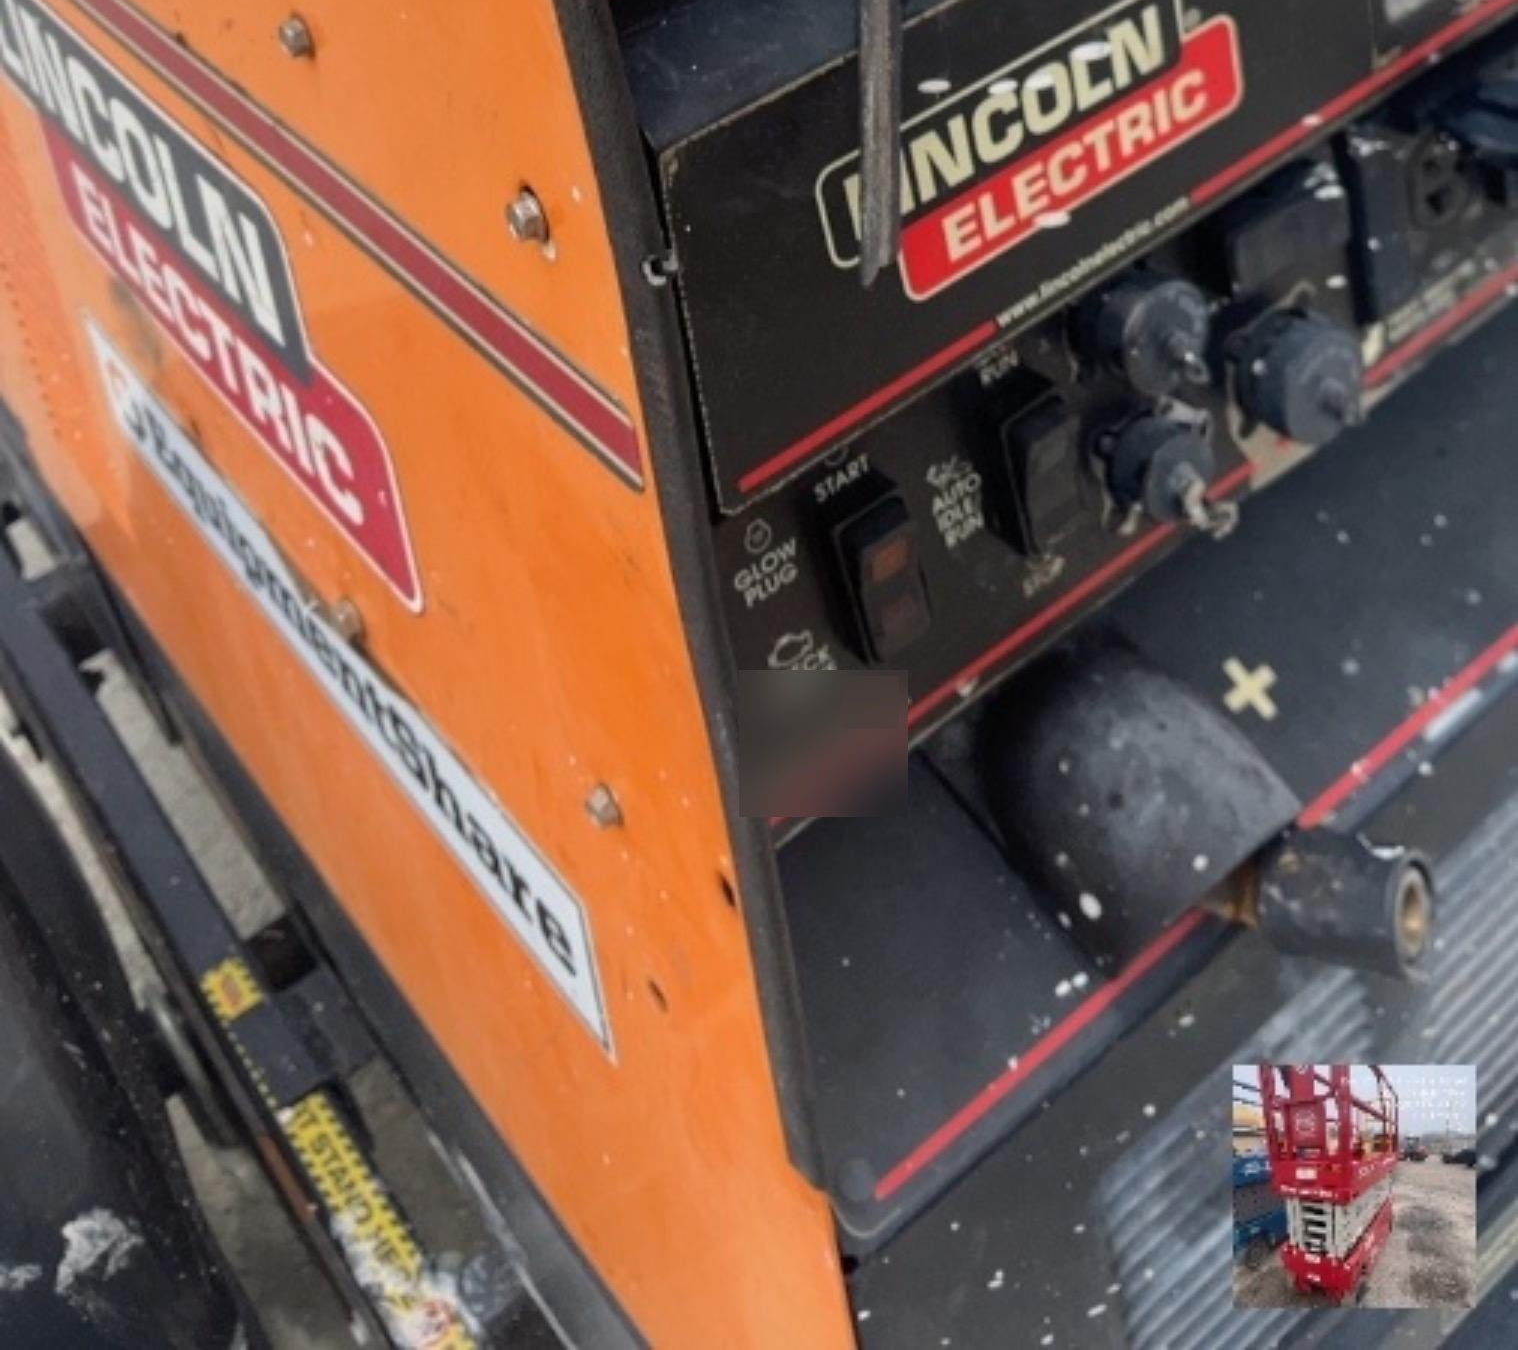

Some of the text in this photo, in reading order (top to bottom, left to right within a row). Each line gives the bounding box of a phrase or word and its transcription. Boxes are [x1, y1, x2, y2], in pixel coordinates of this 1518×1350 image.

[941, 68, 1208, 264] ELECTRIC
[70, 159, 364, 527] ELECTRIC
[814, 452, 869, 503] START
[734, 537, 797, 591] GLOW
[743, 562, 798, 610] PLUG
